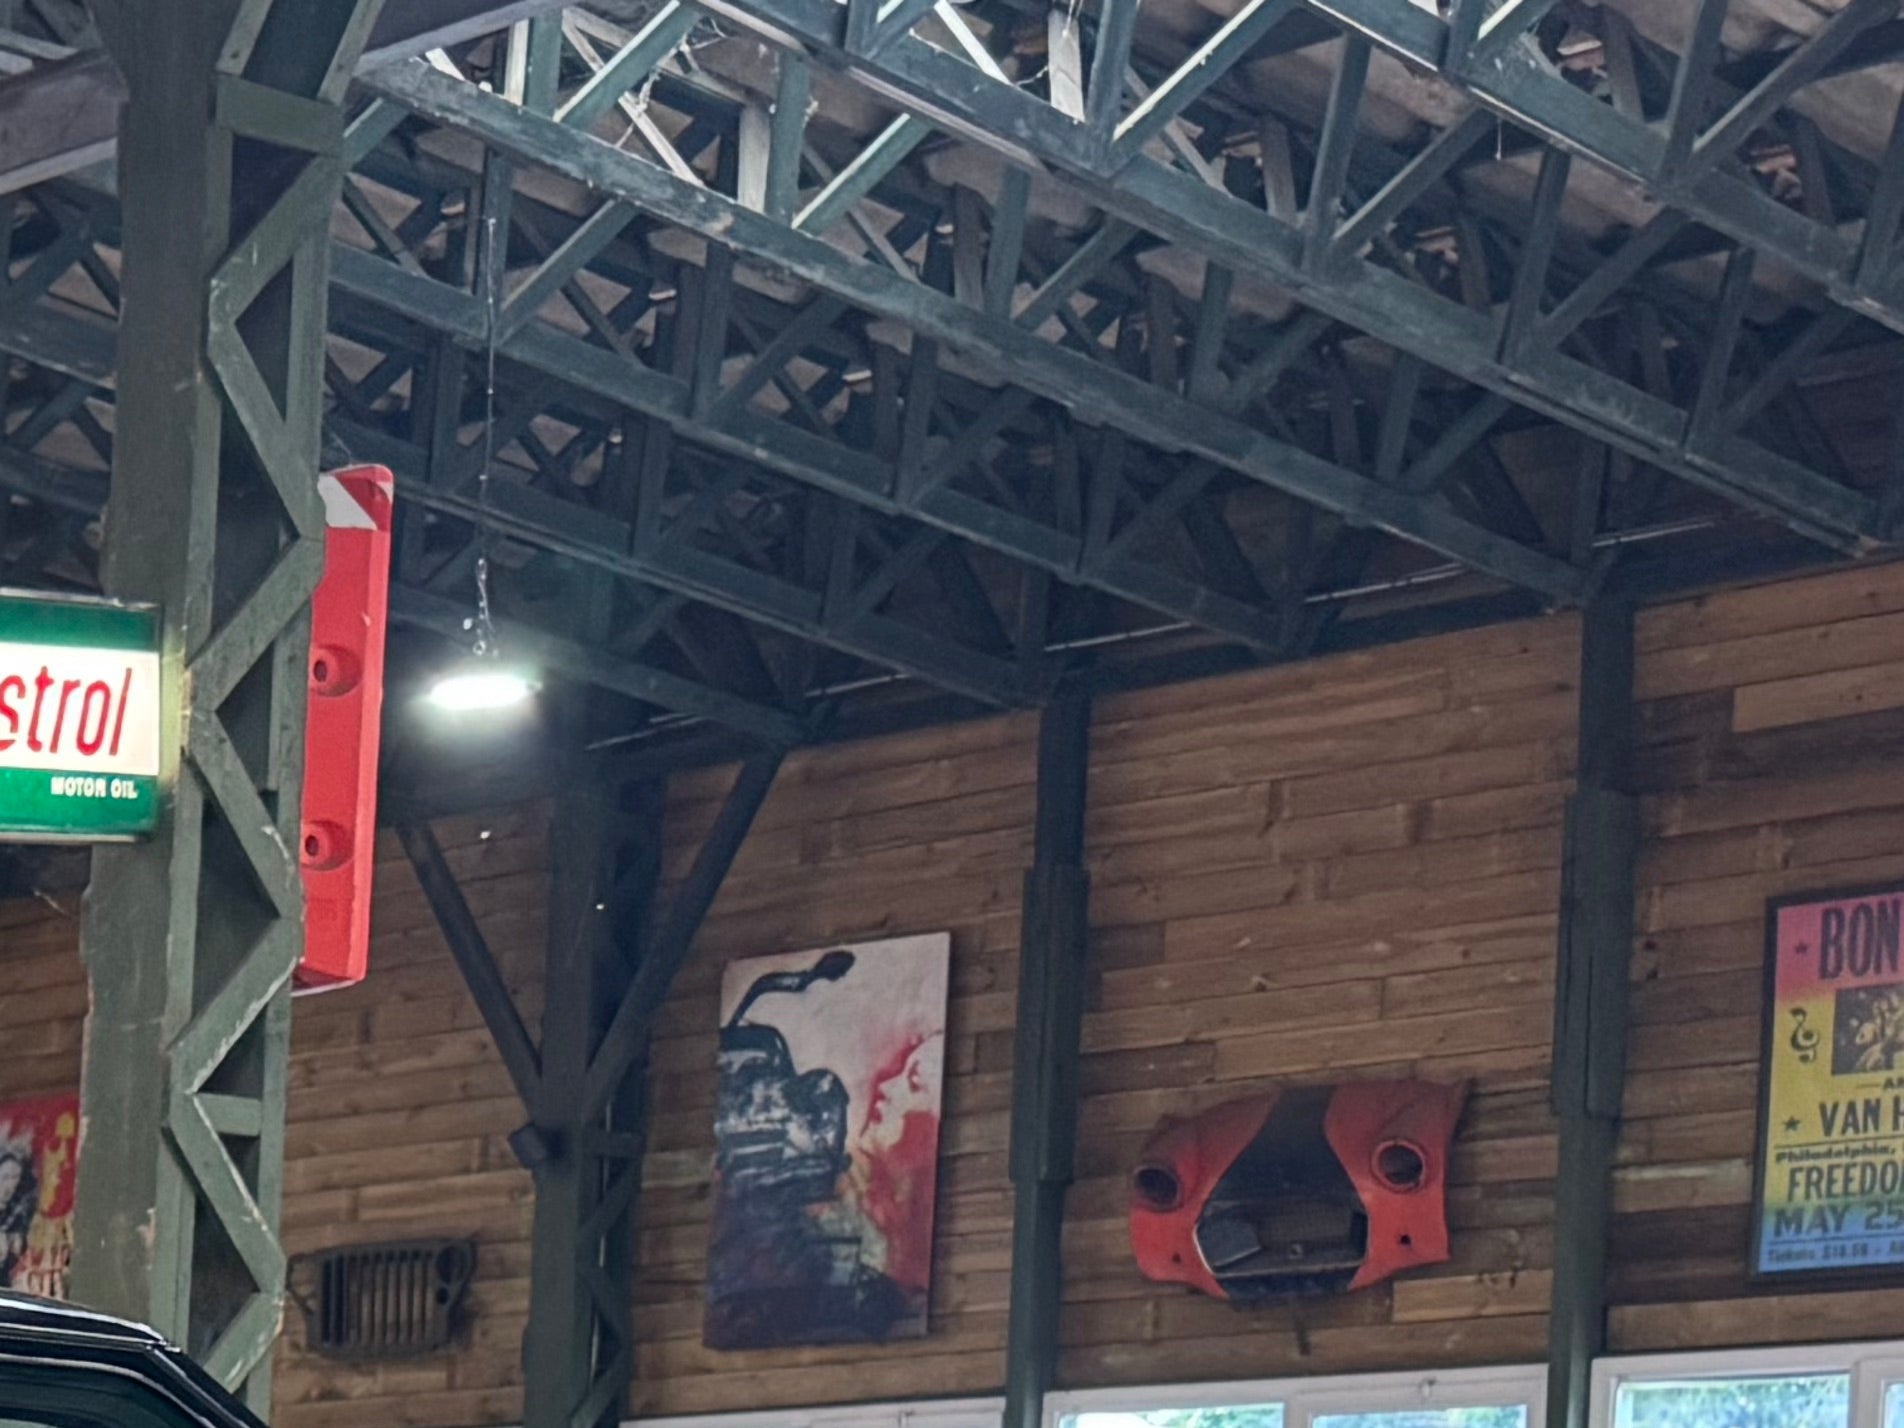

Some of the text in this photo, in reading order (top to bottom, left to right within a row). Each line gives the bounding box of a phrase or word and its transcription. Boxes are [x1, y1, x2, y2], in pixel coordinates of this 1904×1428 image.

[50, 776, 139, 800] MOTOR OIL
[1819, 1098, 1880, 1138] VAN
[1789, 1160, 1904, 1201] FREEDO
[1773, 1203, 1850, 1238] MAY
